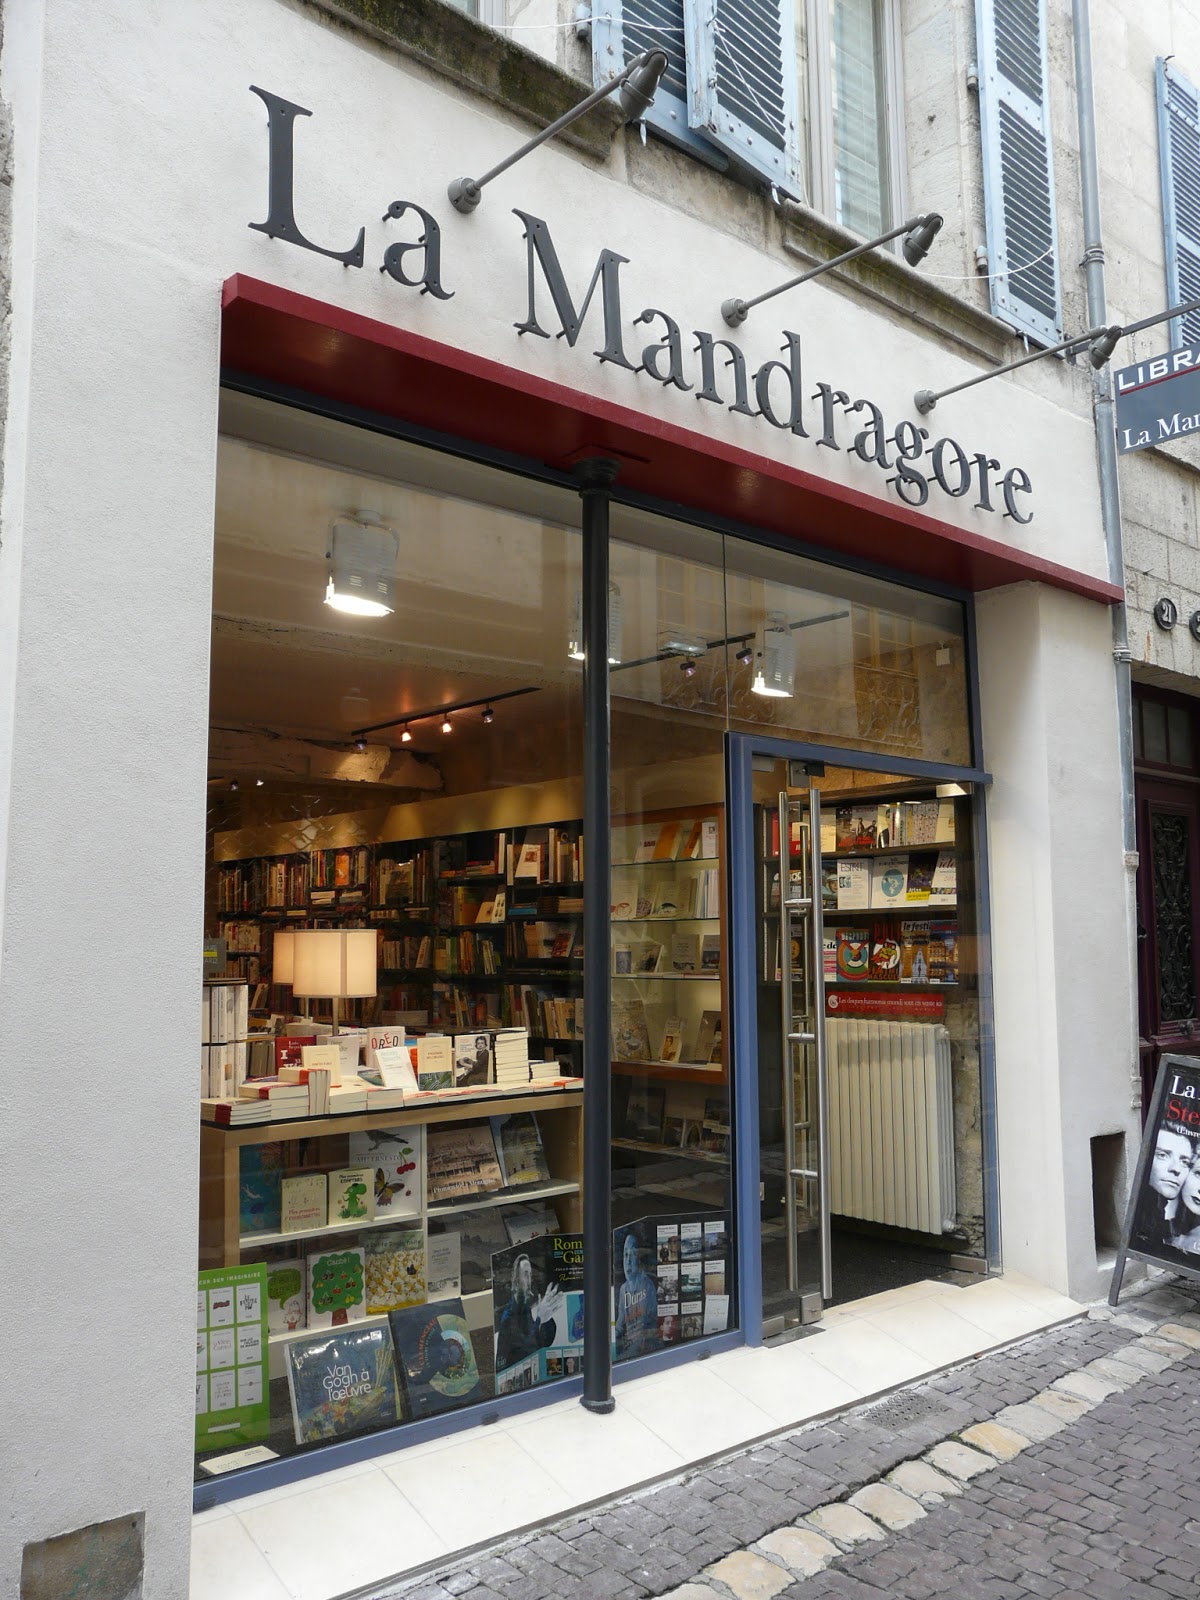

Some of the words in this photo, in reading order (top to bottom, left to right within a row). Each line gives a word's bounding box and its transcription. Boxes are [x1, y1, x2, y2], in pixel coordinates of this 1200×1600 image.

[248, 85, 455, 300] La
[512, 208, 1034, 525] Mandragore
[1122, 428, 1151, 450] La
[1161, 602, 1173, 623] 21
[371, 1032, 399, 1050] OREO
[1169, 1074, 1196, 1099] La
[1167, 1099, 1200, 1126] Ste
[624, 1288, 647, 1310] Duras
[322, 1373, 358, 1390] Gogh
[361, 1368, 370, 1380] à
[327, 1364, 352, 1379] Van
